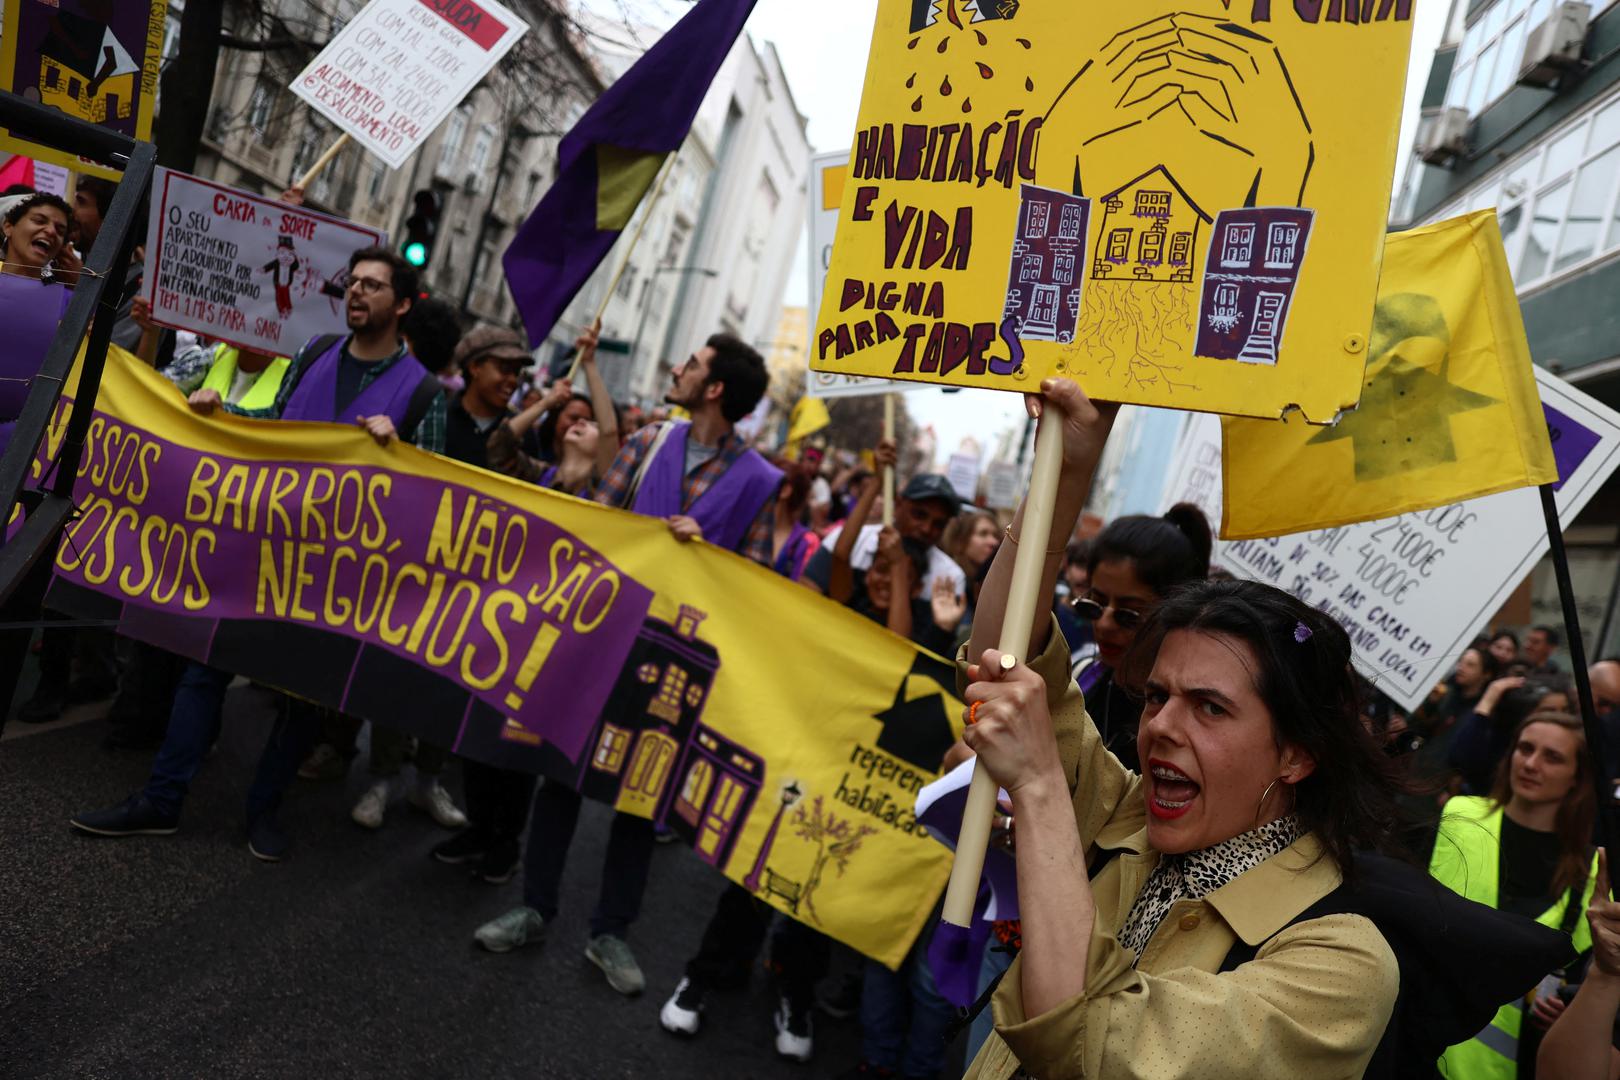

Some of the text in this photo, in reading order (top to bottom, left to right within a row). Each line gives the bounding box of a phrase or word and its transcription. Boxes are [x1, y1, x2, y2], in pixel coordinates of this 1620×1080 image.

[375, 8, 404, 36] COM
[432, 0, 483, 32] JUDA
[355, 26, 387, 56] COM
[335, 46, 368, 78] COM
[315, 63, 422, 142] ALOJAMENTO LOCAL
[315, 83, 404, 151] DESALOJAMENTO
[169, 204, 211, 233] O SEU
[213, 193, 256, 223] CARTA
[279, 213, 318, 241] SORTE
[852, 186, 880, 222] E
[884, 199, 973, 271] VIDA
[163, 244, 252, 281] FOI ADQUIRIDO POR
[165, 226, 239, 260] APARTAMENTO
[161, 258, 175, 273] UM
[175, 262, 204, 281] FUNDO
[159, 273, 238, 308] INTERNACIONAL
[840, 278, 945, 319] DIGNA
[159, 289, 179, 312] TEM
[218, 306, 247, 334] PARA
[819, 311, 1025, 377] PARA TODES
[425, 487, 529, 585] NÃO
[526, 537, 621, 634] SÃO
[1355, 542, 1421, 606] 4000€
[255, 538, 562, 711] NEGÓCIOS!
[1311, 561, 1340, 588] 50%
[1338, 584, 1366, 610] DAS
[1367, 606, 1411, 642] CASAS
[1409, 635, 1433, 658] EM
[1378, 647, 1419, 683] LOCAL
